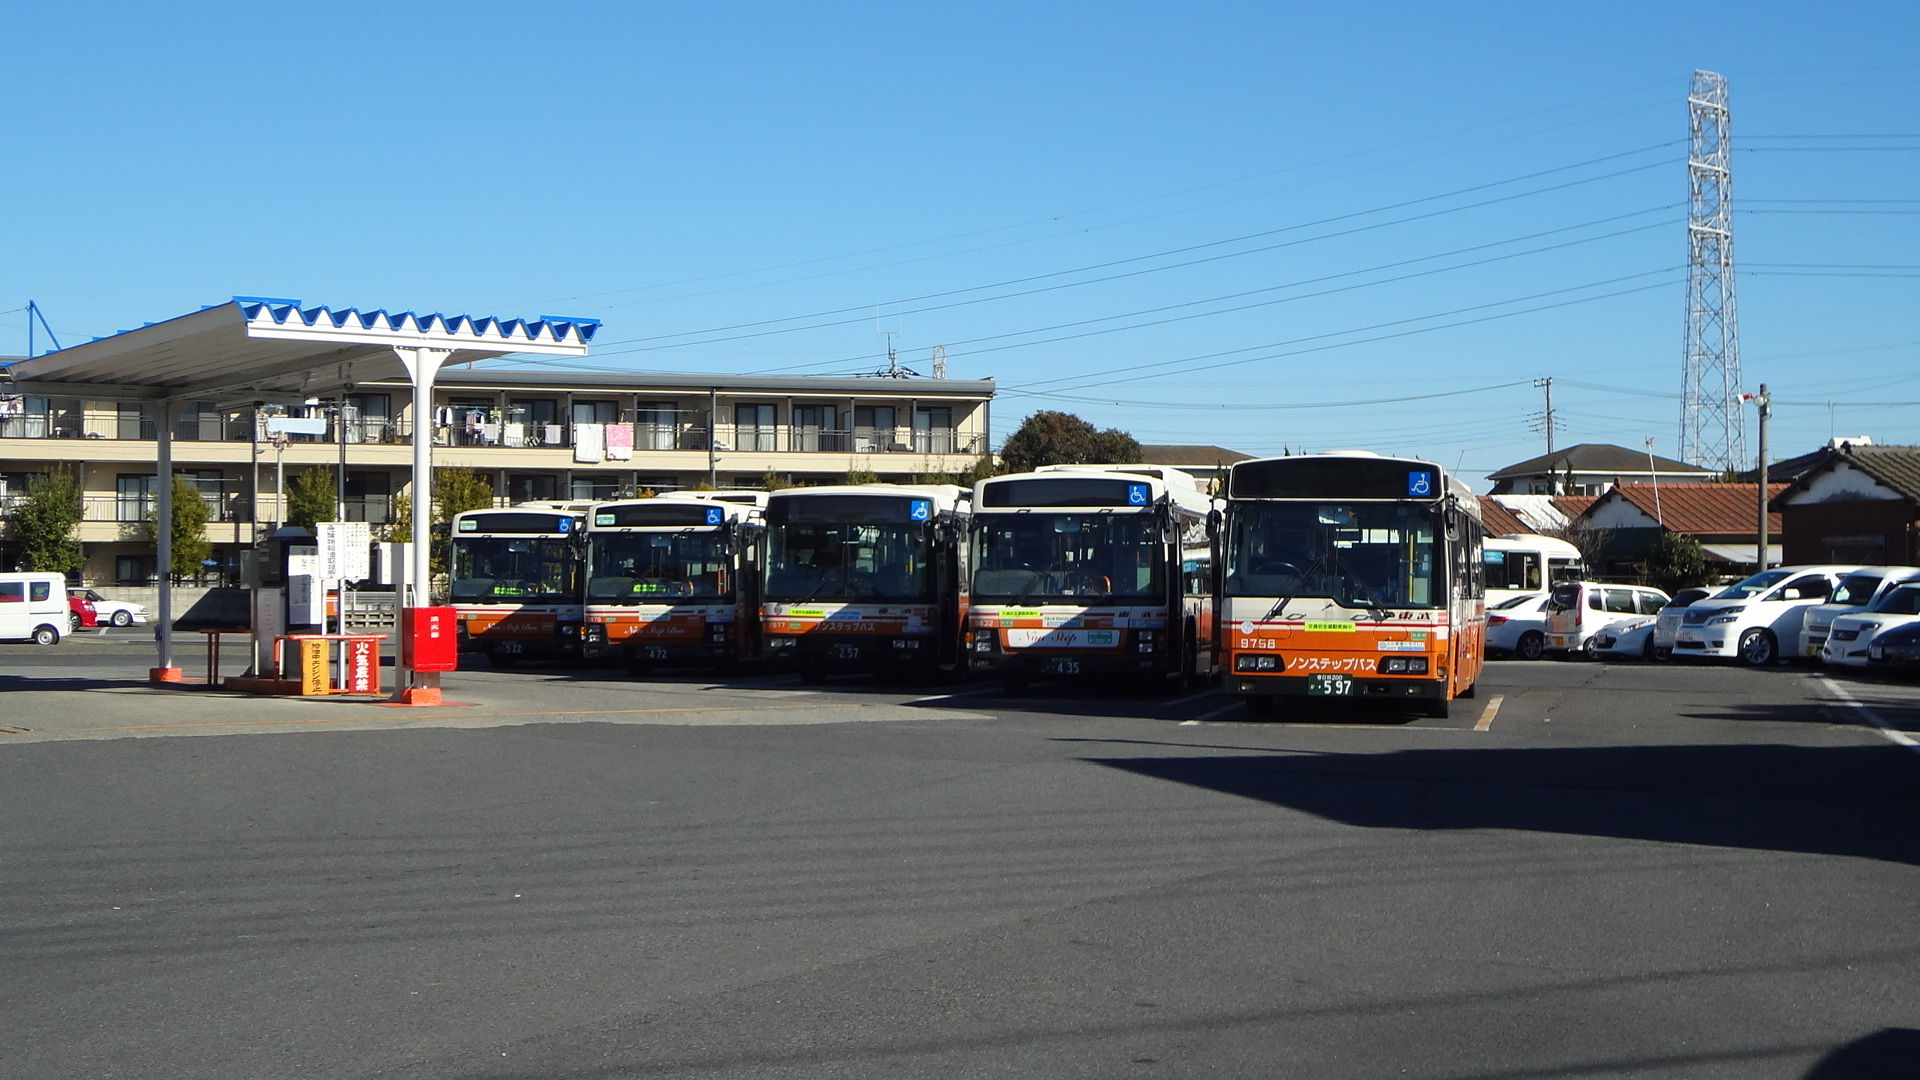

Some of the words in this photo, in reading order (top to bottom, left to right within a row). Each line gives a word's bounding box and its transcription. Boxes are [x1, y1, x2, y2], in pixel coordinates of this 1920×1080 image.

[814, 621, 876, 632] ノンステップバス
[1050, 630, 1079, 646] Step
[1240, 638, 1276, 649] 9758
[838, 647, 860, 660] 257
[355, 641, 369, 691] 火気厳禁
[1056, 661, 1081, 674] 435
[1286, 656, 1377, 672] ノンステップバス
